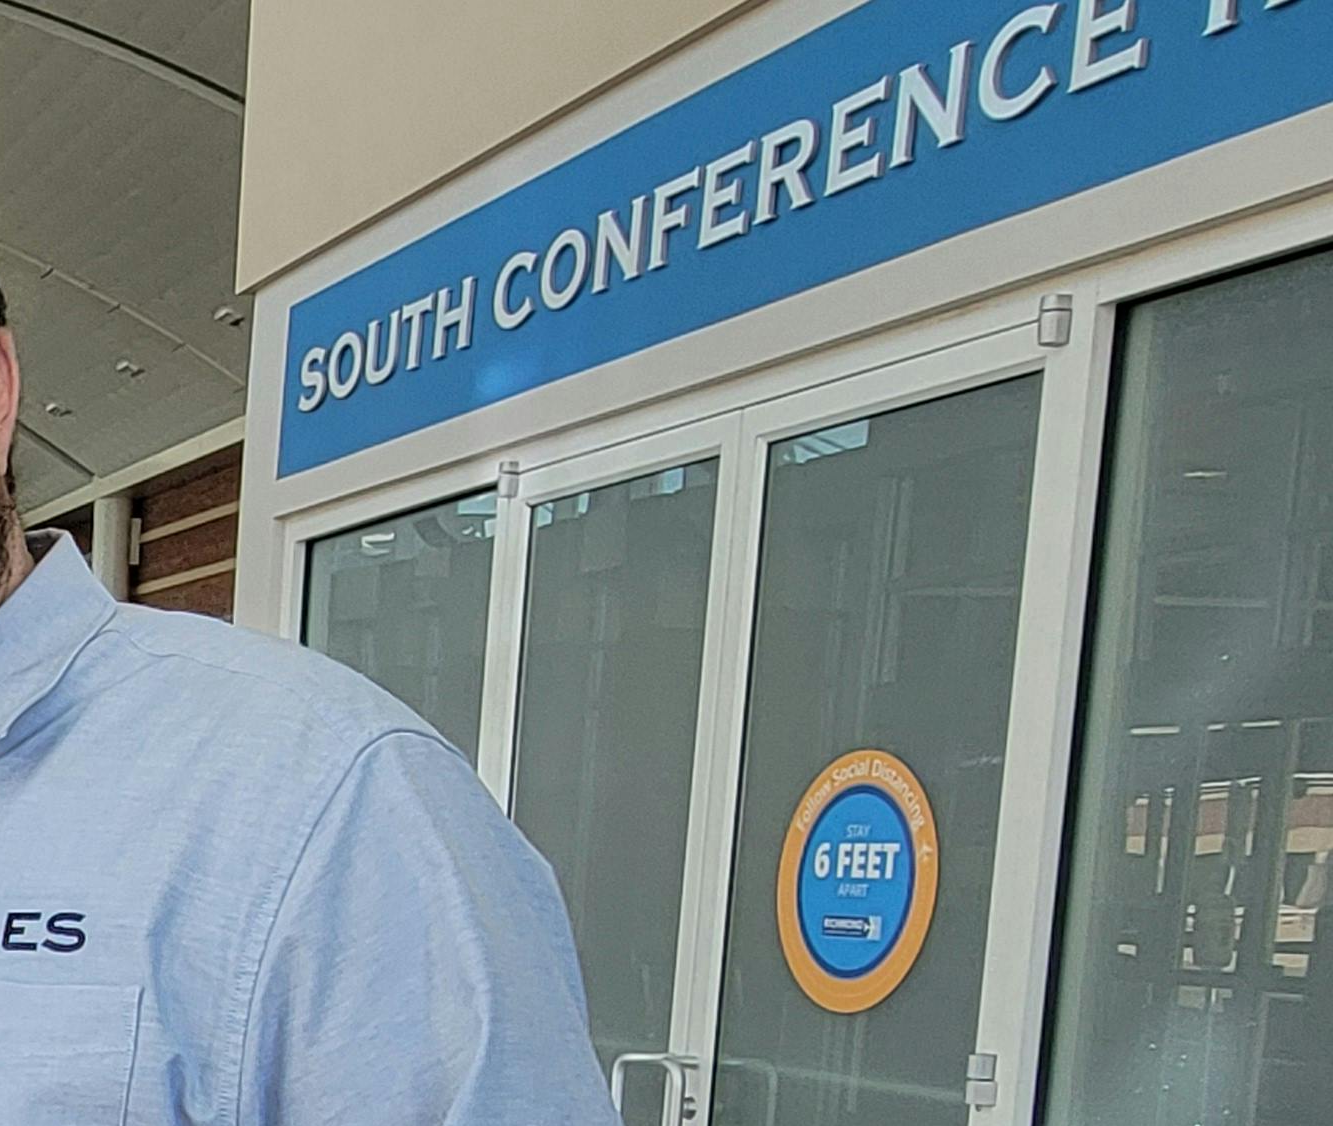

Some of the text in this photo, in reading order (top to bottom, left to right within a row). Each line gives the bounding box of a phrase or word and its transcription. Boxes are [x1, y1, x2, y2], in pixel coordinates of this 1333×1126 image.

[298, 0, 1149, 412] SOUTH CONFERENCE
[796, 759, 925, 832] Follow Social Distancing
[846, 824, 871, 838] STAY
[814, 842, 900, 879] 6 FEET
[837, 883, 869, 897] APART
